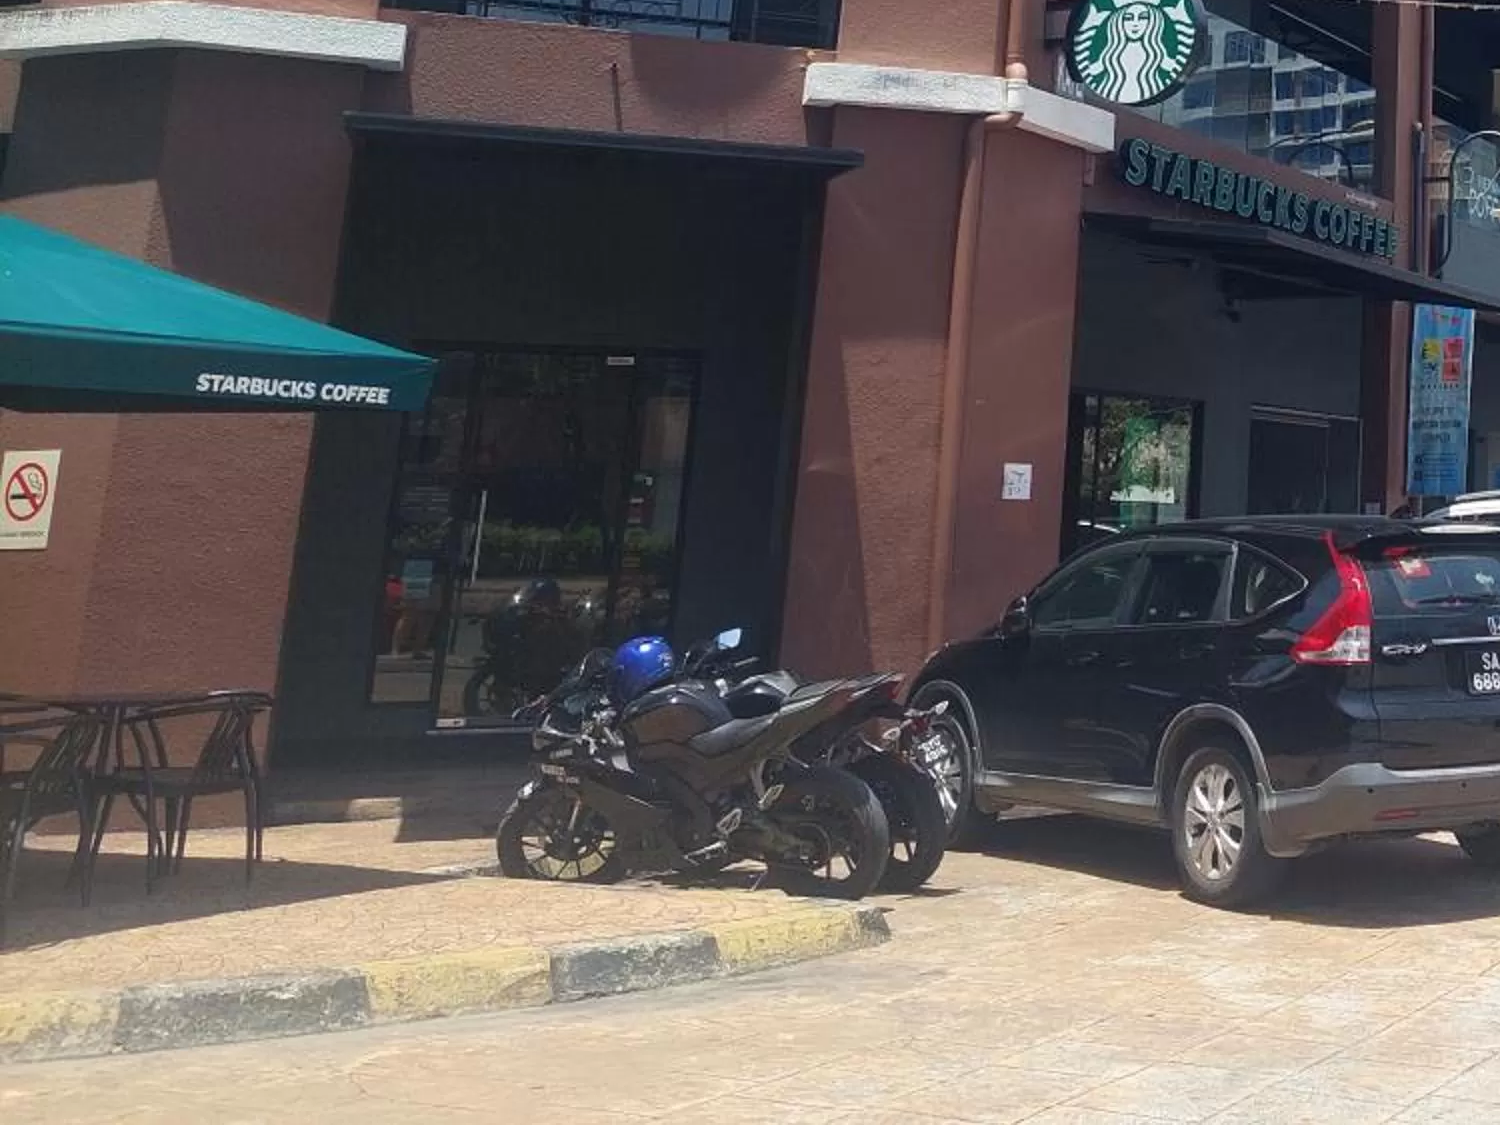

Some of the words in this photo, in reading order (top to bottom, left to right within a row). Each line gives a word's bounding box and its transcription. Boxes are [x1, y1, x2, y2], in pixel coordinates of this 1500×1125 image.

[1125, 138, 1309, 234] STARBUCKS
[1314, 199, 1399, 258] COFFEE
[195, 373, 316, 399] STARBUCKS
[320, 383, 391, 404] COFFEE
